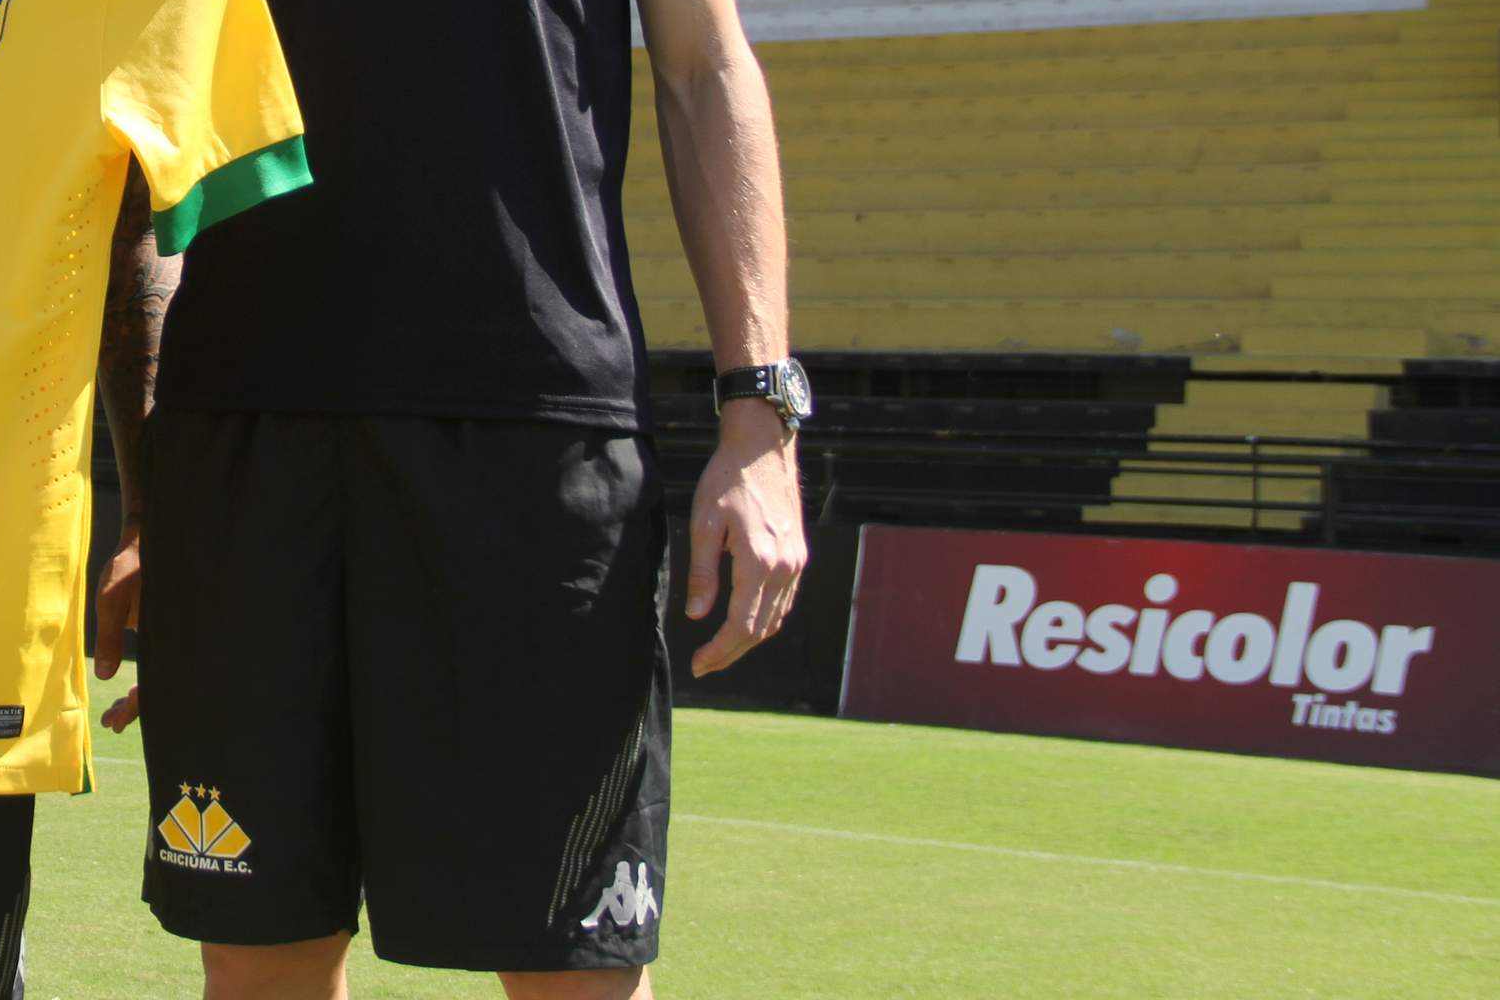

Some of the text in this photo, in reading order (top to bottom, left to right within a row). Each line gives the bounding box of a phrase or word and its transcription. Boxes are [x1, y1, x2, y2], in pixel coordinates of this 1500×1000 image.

[954, 563, 1436, 696] Resicolor
[1290, 693, 1399, 735] Tintas
[159, 849, 253, 874] CRICIÚMA E.C.
